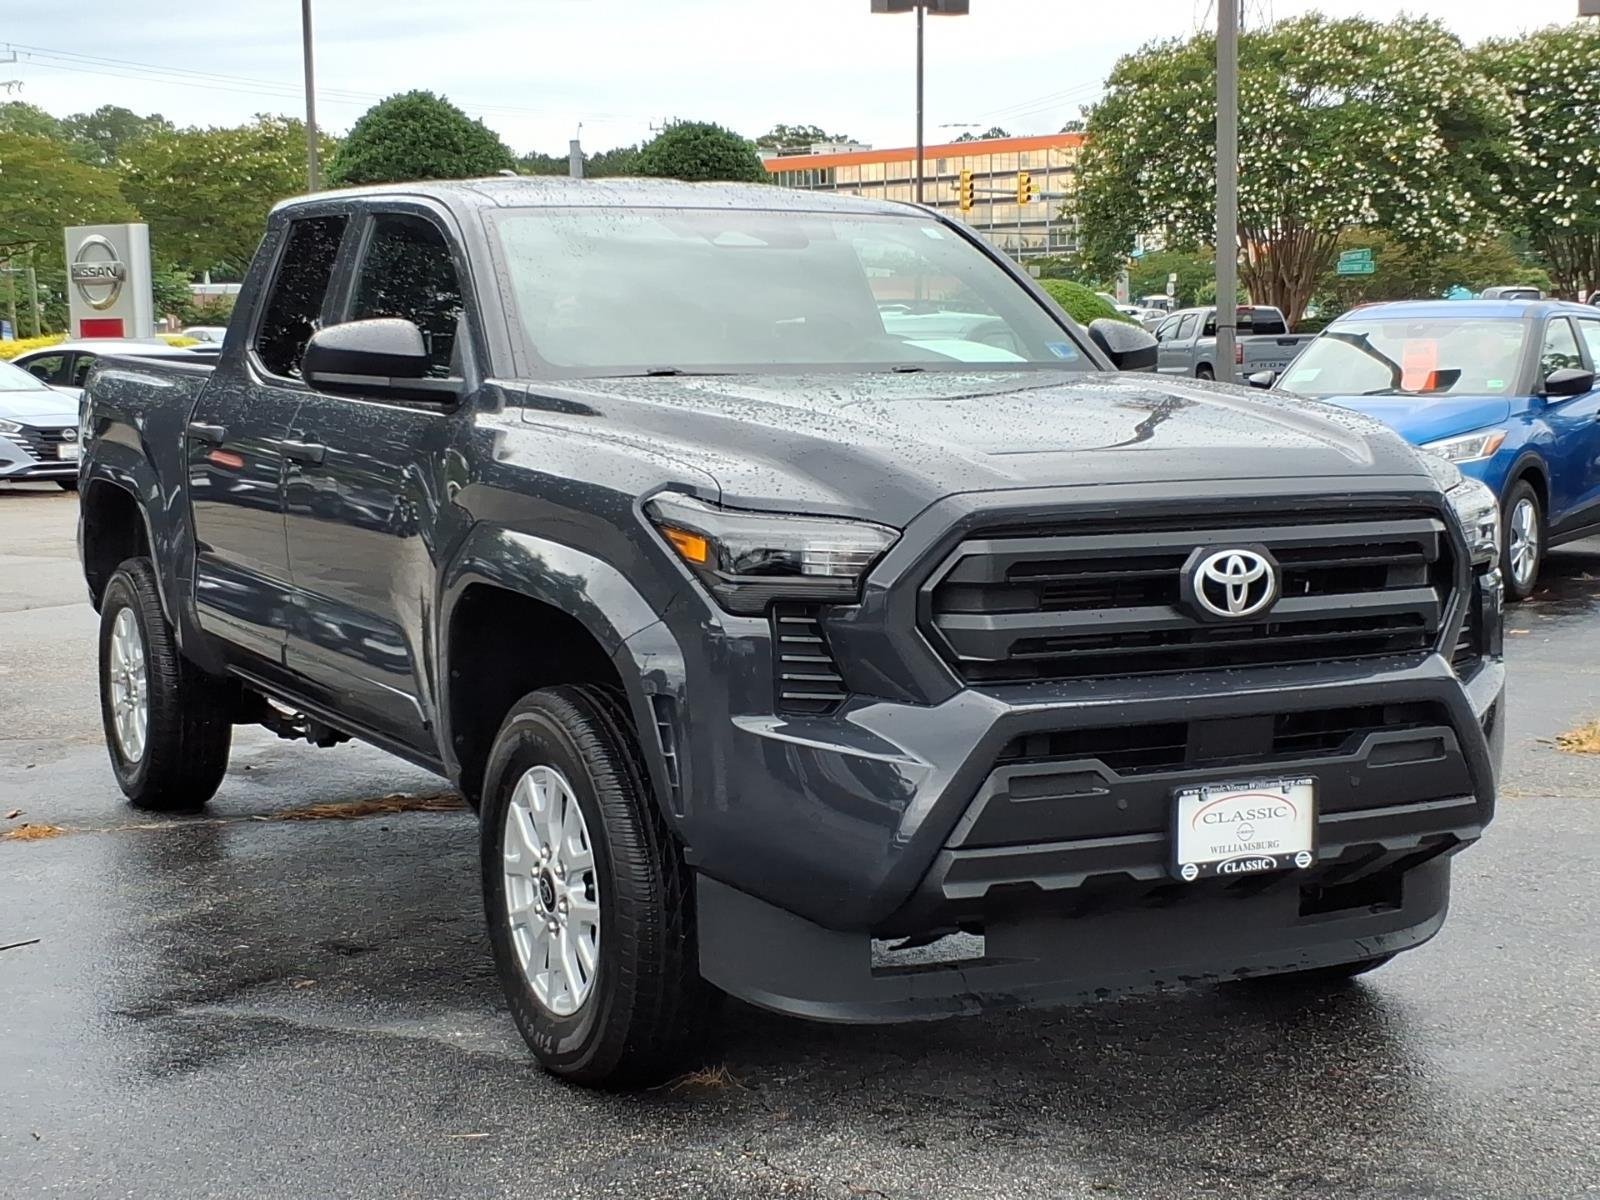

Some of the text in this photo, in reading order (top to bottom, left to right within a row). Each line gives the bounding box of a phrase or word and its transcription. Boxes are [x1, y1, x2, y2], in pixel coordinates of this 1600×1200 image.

[72, 265, 118, 279] SSAN
[1203, 807, 1287, 824] CLASSIC
[1210, 840, 1280, 854] WILLIAMSBURG
[1224, 859, 1270, 873] CLASSIC
